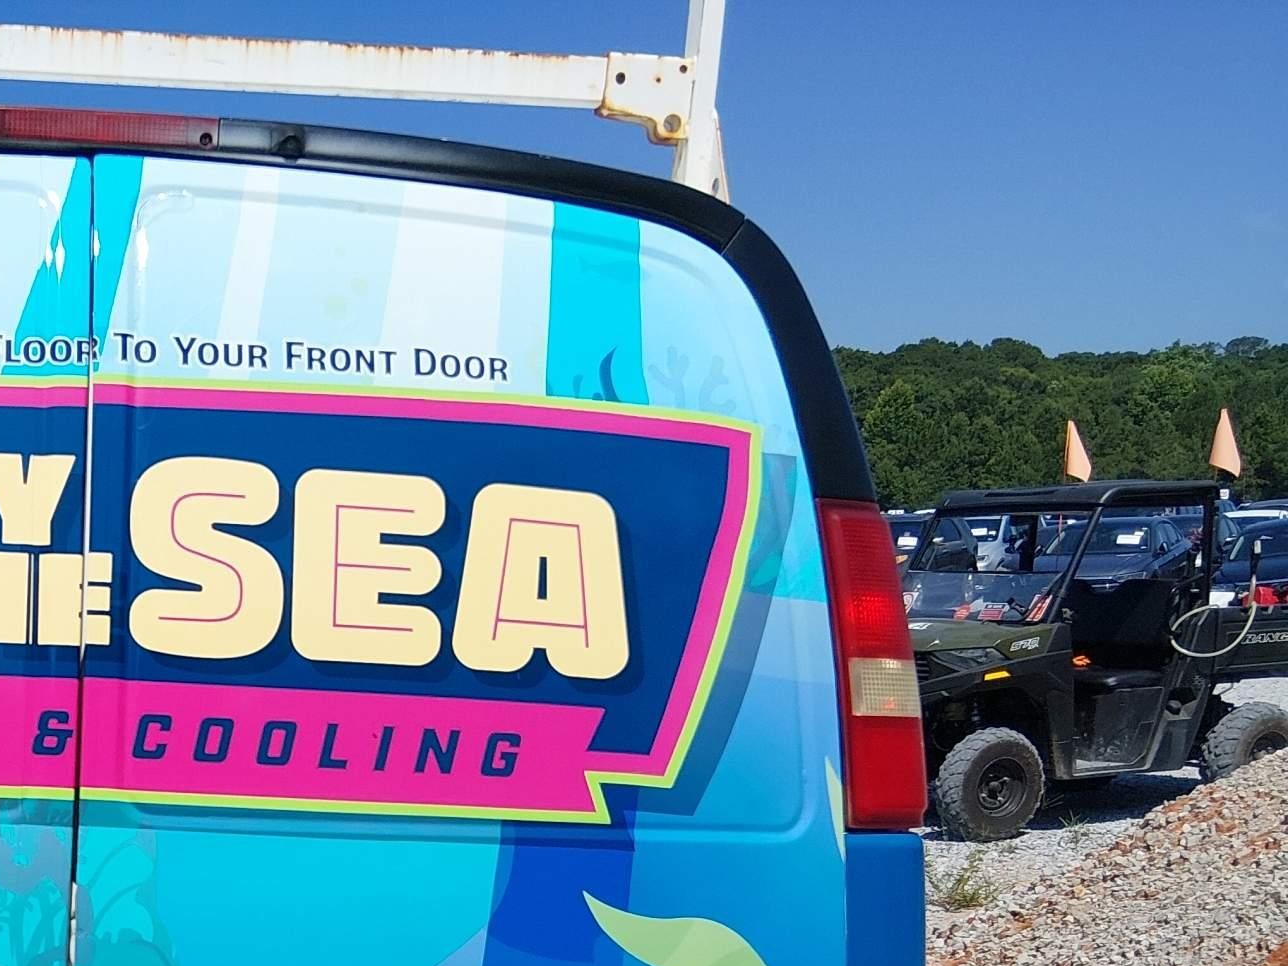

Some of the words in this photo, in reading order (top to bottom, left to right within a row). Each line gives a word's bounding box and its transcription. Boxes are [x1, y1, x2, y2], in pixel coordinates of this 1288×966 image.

[113, 332, 158, 364] TO
[173, 336, 268, 370] YOUR
[284, 340, 398, 376] FRONT
[413, 347, 510, 382] DOOR
[128, 456, 630, 680] SEA
[32, 710, 75, 756] &
[132, 713, 523, 778] COOLING
